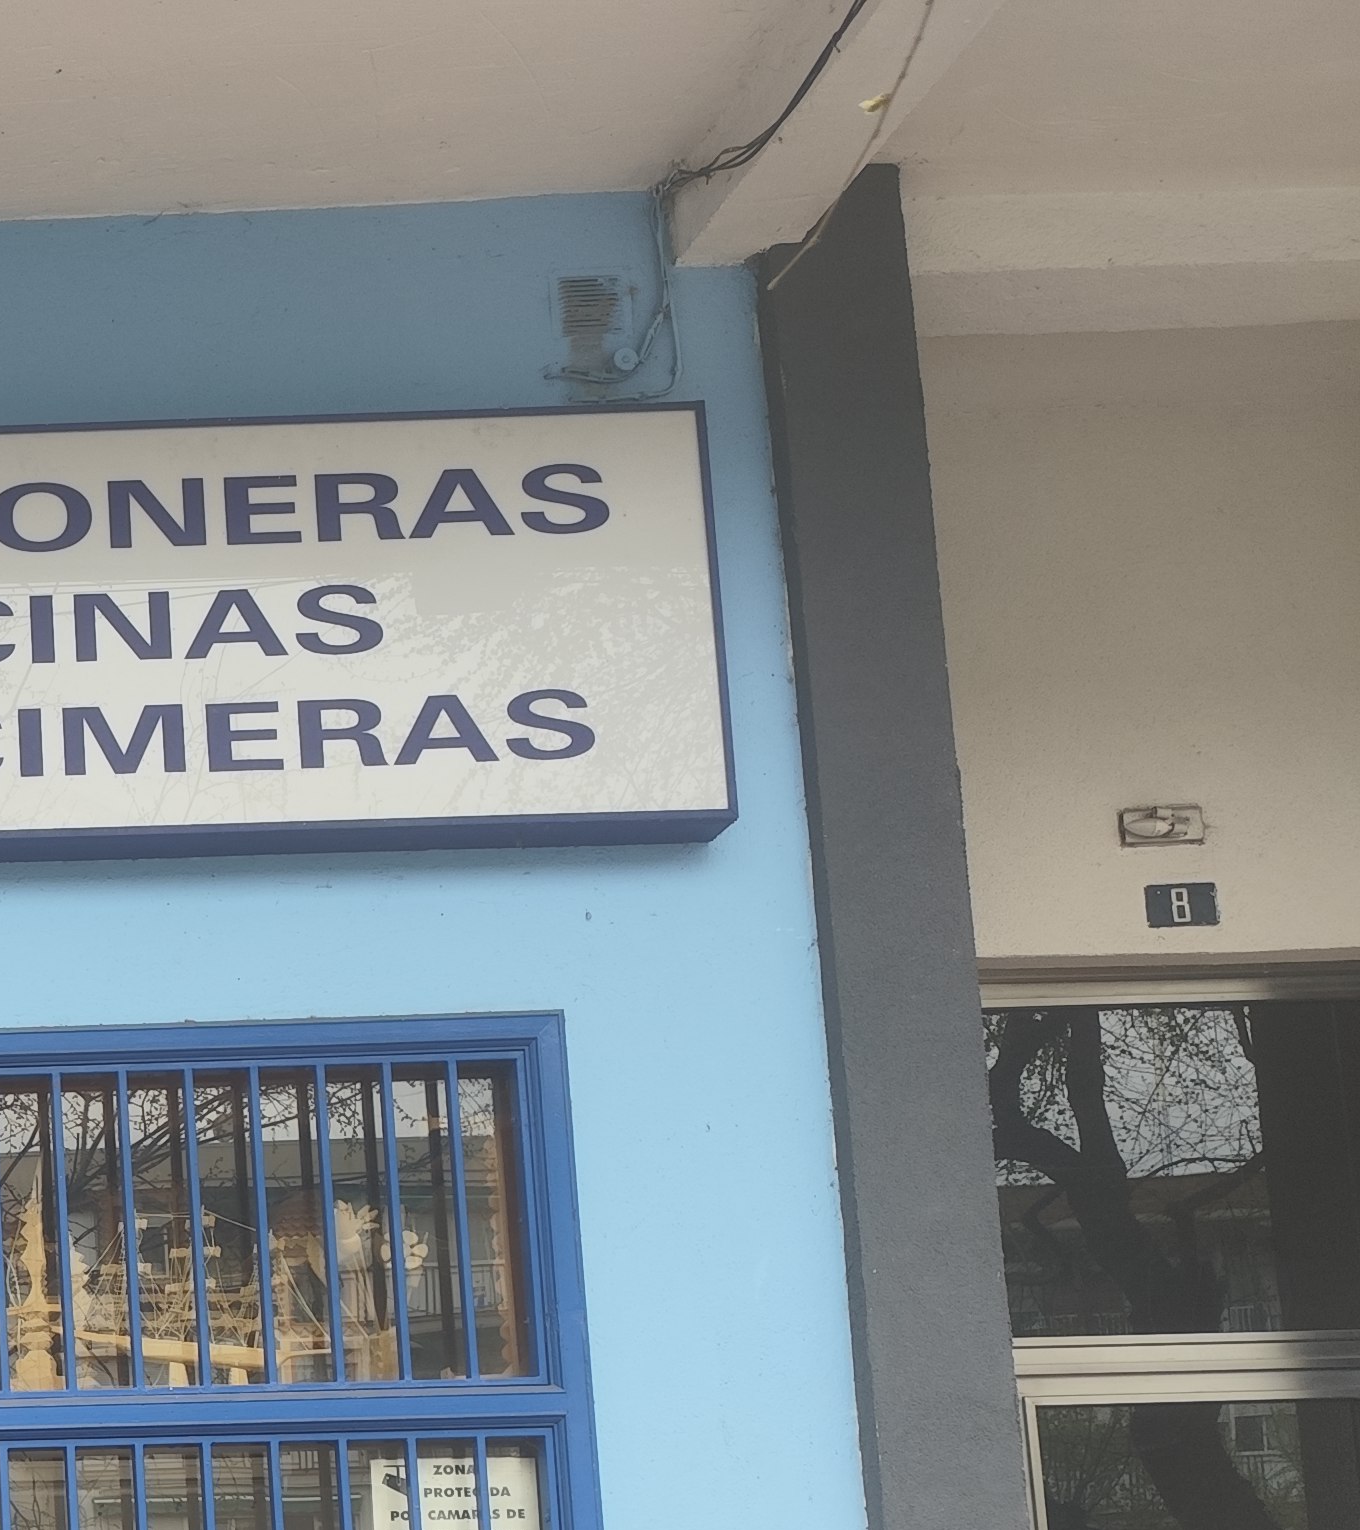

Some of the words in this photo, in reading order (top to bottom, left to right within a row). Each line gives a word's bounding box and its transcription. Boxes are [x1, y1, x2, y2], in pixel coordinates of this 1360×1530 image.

[1170, 887, 1192, 923] 8
[433, 1464, 476, 1475] ZONA
[424, 1487, 511, 1498] PROTEDA
[390, 1510, 412, 1521] PO
[428, 1509, 501, 1520] CAMARS
[507, 1508, 526, 1519] DE
